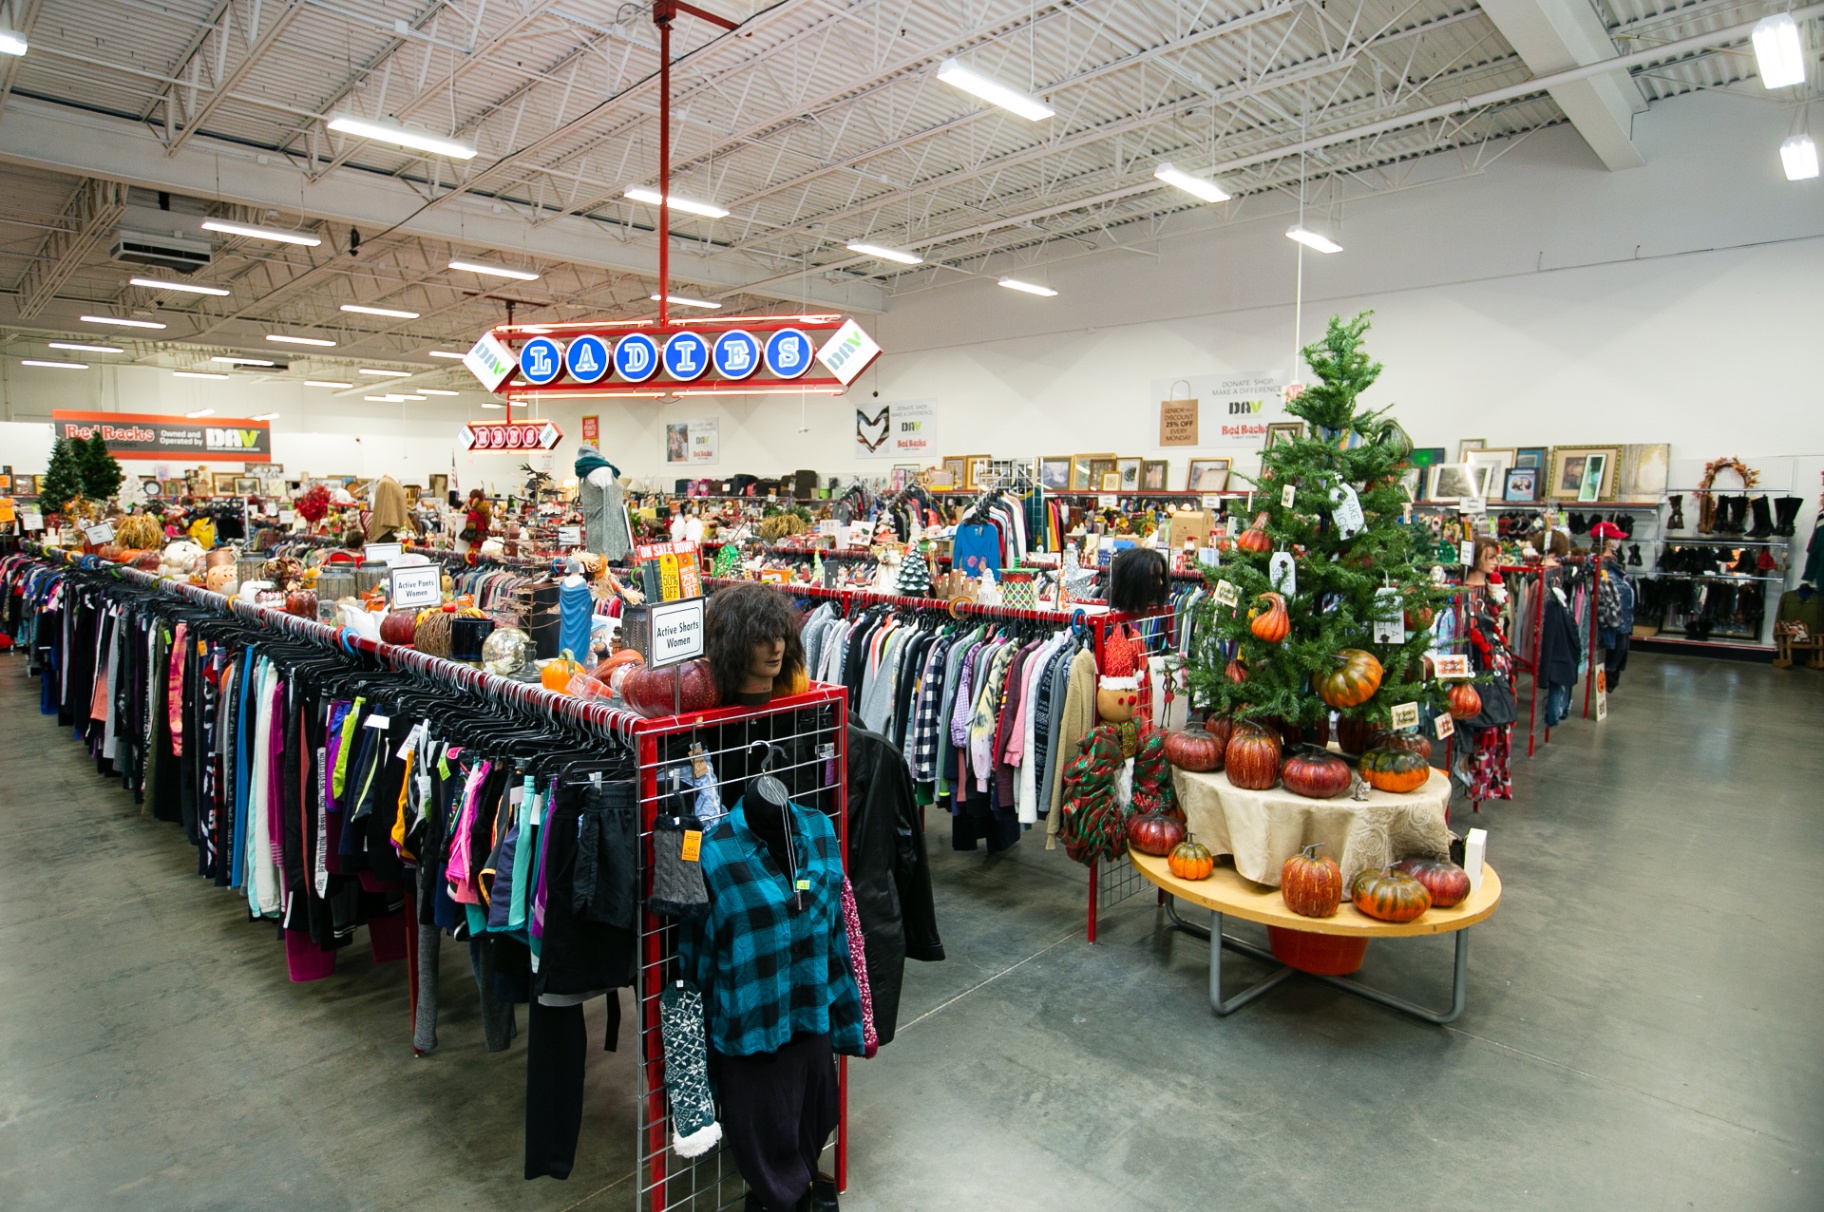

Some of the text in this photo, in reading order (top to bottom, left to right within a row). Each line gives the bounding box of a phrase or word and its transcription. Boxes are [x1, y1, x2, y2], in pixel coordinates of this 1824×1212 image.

[529, 336, 801, 376] LADIES
[826, 330, 863, 371] DAV
[1228, 401, 1263, 415] DAV
[65, 424, 155, 442] Red Racks
[901, 421, 922, 432] DAV
[1221, 425, 1240, 435] Red
[160, 429, 202, 439] Owned and
[205, 428, 259, 448] DAV
[160, 437, 204, 447] Operated by
[1345, 496, 1360, 521] TAKE
[640, 545, 653, 559] ON
[653, 543, 673, 557] SALE
[398, 581, 417, 589] Active
[662, 574, 679, 587] 50%
[405, 590, 428, 598] Women
[664, 585, 678, 599] OFF
[684, 584, 699, 598] OFF
[656, 620, 699, 638] Active Shorts
[666, 635, 691, 649] Women
